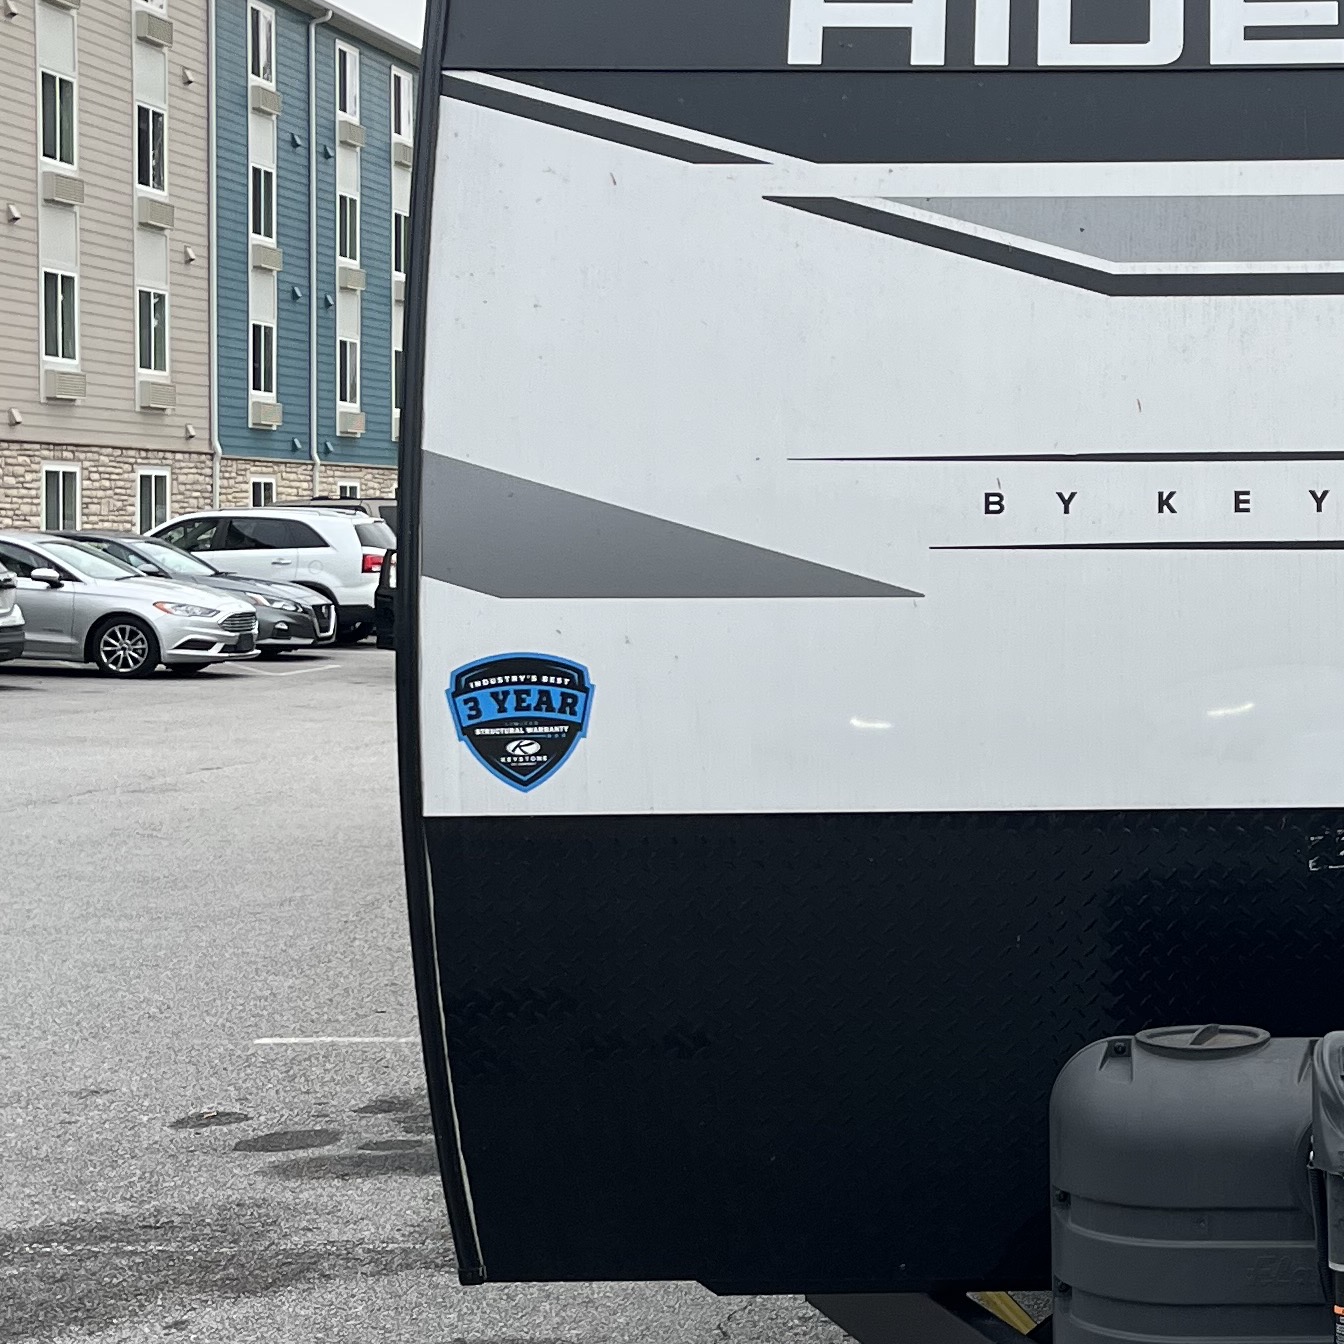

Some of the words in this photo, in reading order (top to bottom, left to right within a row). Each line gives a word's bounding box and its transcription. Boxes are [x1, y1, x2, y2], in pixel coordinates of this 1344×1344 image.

[984, 491, 1078, 515] BY
[469, 675, 538, 689] INDUSTRY'S
[542, 675, 571, 685] BEST
[463, 697, 483, 720] 3
[490, 689, 578, 716] YEAR
[475, 727, 525, 735] STRUCTURAL
